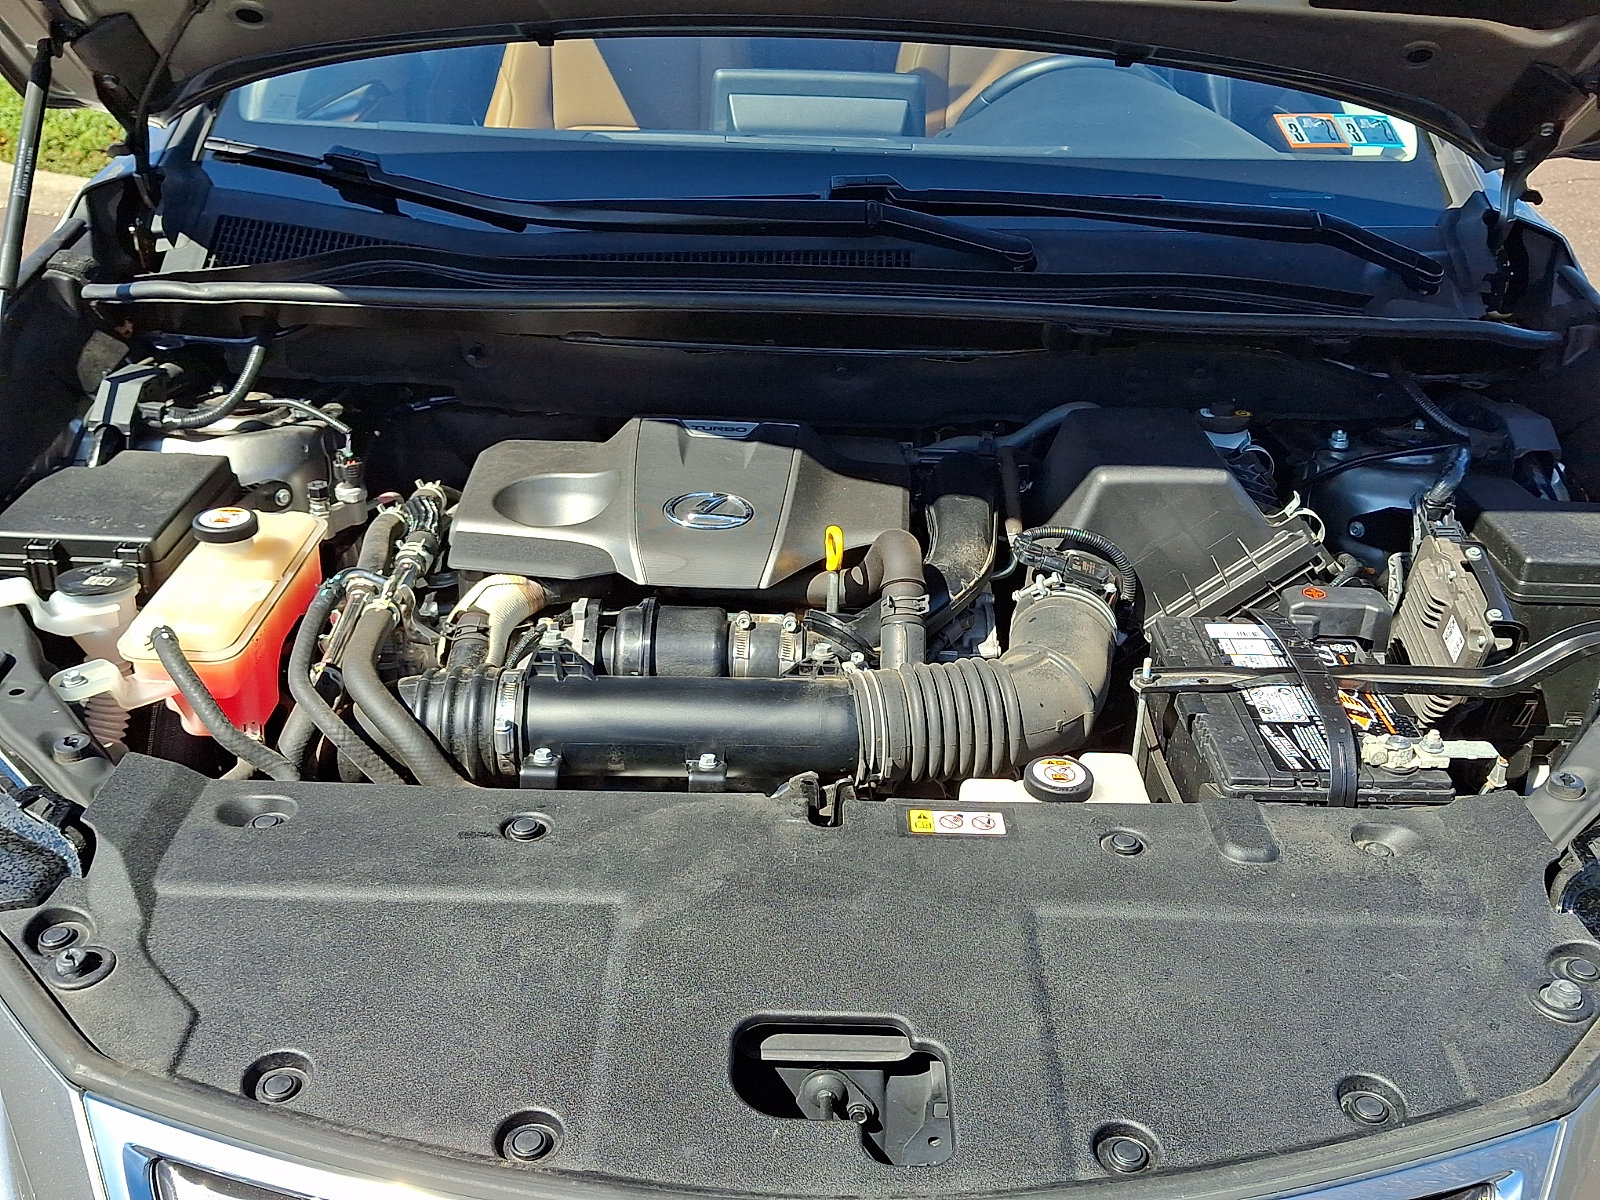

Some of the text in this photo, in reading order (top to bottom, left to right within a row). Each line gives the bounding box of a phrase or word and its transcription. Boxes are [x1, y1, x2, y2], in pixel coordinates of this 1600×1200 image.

[1288, 123, 1305, 142] 3
[1346, 123, 1362, 142] 3
[690, 425, 747, 433] TURBO
